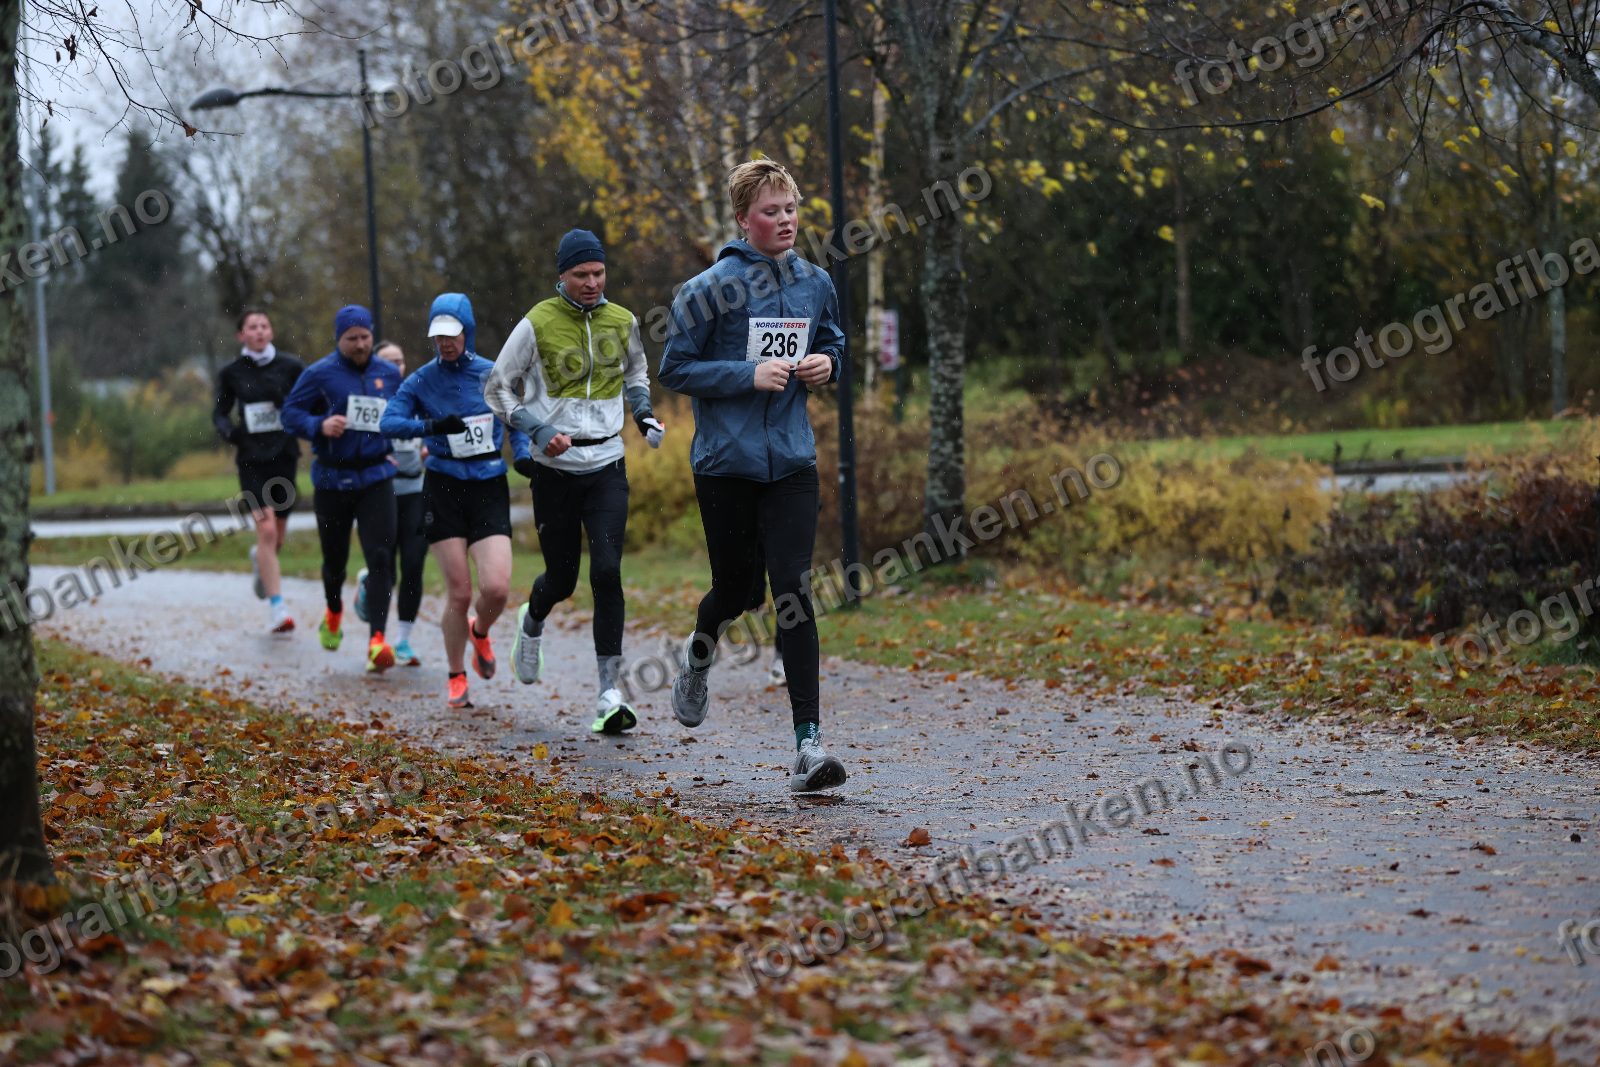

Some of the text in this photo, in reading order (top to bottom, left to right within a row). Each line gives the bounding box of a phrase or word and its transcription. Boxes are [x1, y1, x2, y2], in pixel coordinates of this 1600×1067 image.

[760, 332, 798, 357] 236
[355, 406, 379, 424] 769
[465, 426, 483, 445] 49
